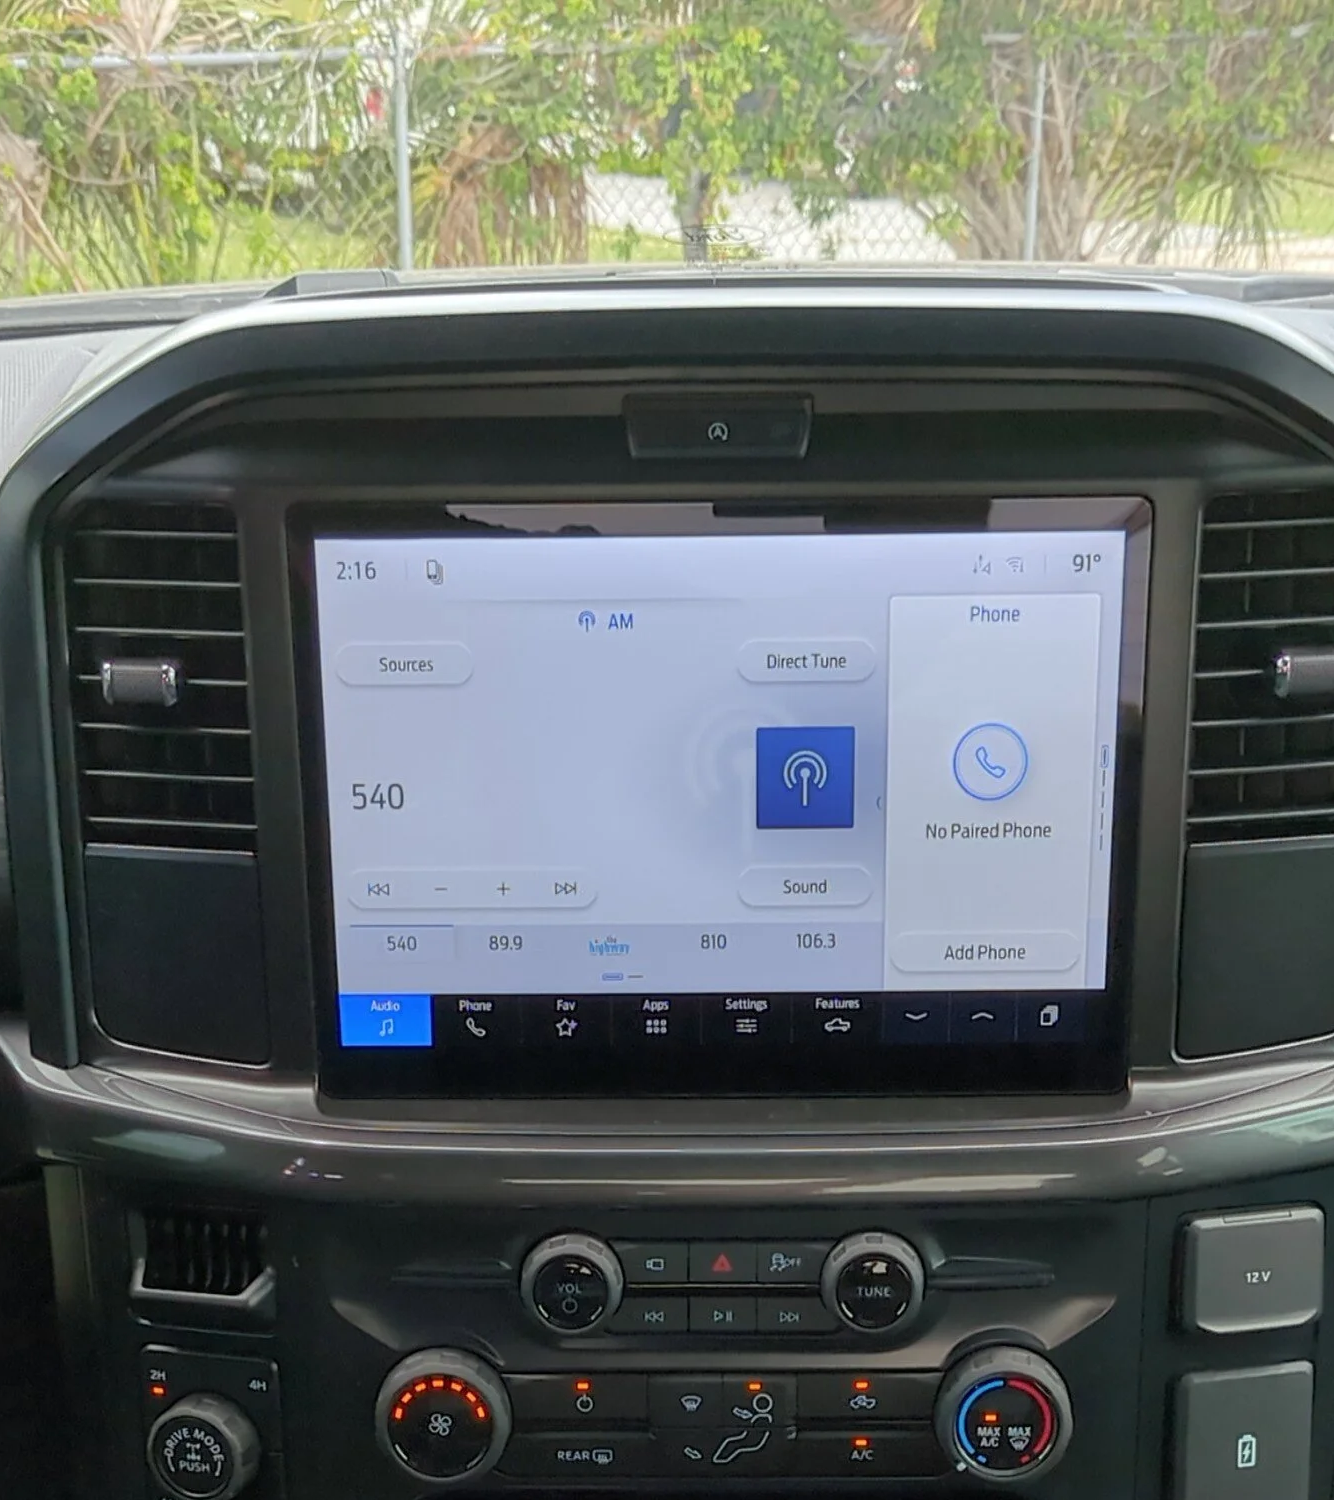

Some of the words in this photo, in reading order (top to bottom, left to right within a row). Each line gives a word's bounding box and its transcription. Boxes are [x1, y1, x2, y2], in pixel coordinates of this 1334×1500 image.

[335, 561, 377, 581] 2:16
[969, 605, 1020, 623] Phone
[608, 613, 634, 630] AM
[379, 656, 434, 673] Sources
[767, 653, 808, 669] Direct
[811, 653, 847, 669] Tune
[351, 783, 405, 810] 540
[925, 823, 947, 840] No
[950, 822, 1000, 839] Paired
[1003, 822, 1052, 838] Phone
[783, 880, 827, 895] Sound
[386, 935, 417, 952] 540
[488, 935, 523, 951] 89.9
[700, 934, 727, 950] 810
[796, 933, 836, 949] 106.3
[944, 945, 975, 961] Add
[977, 944, 1026, 960] Phone
[370, 999, 400, 1012] Audio
[458, 999, 492, 1012] Phone
[556, 999, 575, 1012] Fav
[642, 999, 669, 1013] Apps
[725, 997, 767, 1012] Settings
[815, 996, 860, 1010] Features
[1245, 1272, 1259, 1283] 12
[1261, 1271, 1271, 1282] V
[557, 1283, 581, 1293] VOL
[857, 1286, 892, 1297] TUNE
[150, 1369, 166, 1381] 2H
[249, 1379, 266, 1391] 4H
[977, 1427, 1000, 1437] MAX
[1008, 1427, 1031, 1437] MAX
[163, 1427, 191, 1457] DRIVE
[193, 1428, 224, 1461] MODE
[980, 1437, 999, 1447] A/C
[557, 1450, 590, 1461] REAR
[851, 1450, 874, 1460] A/C
[179, 1461, 210, 1473] PUSH
